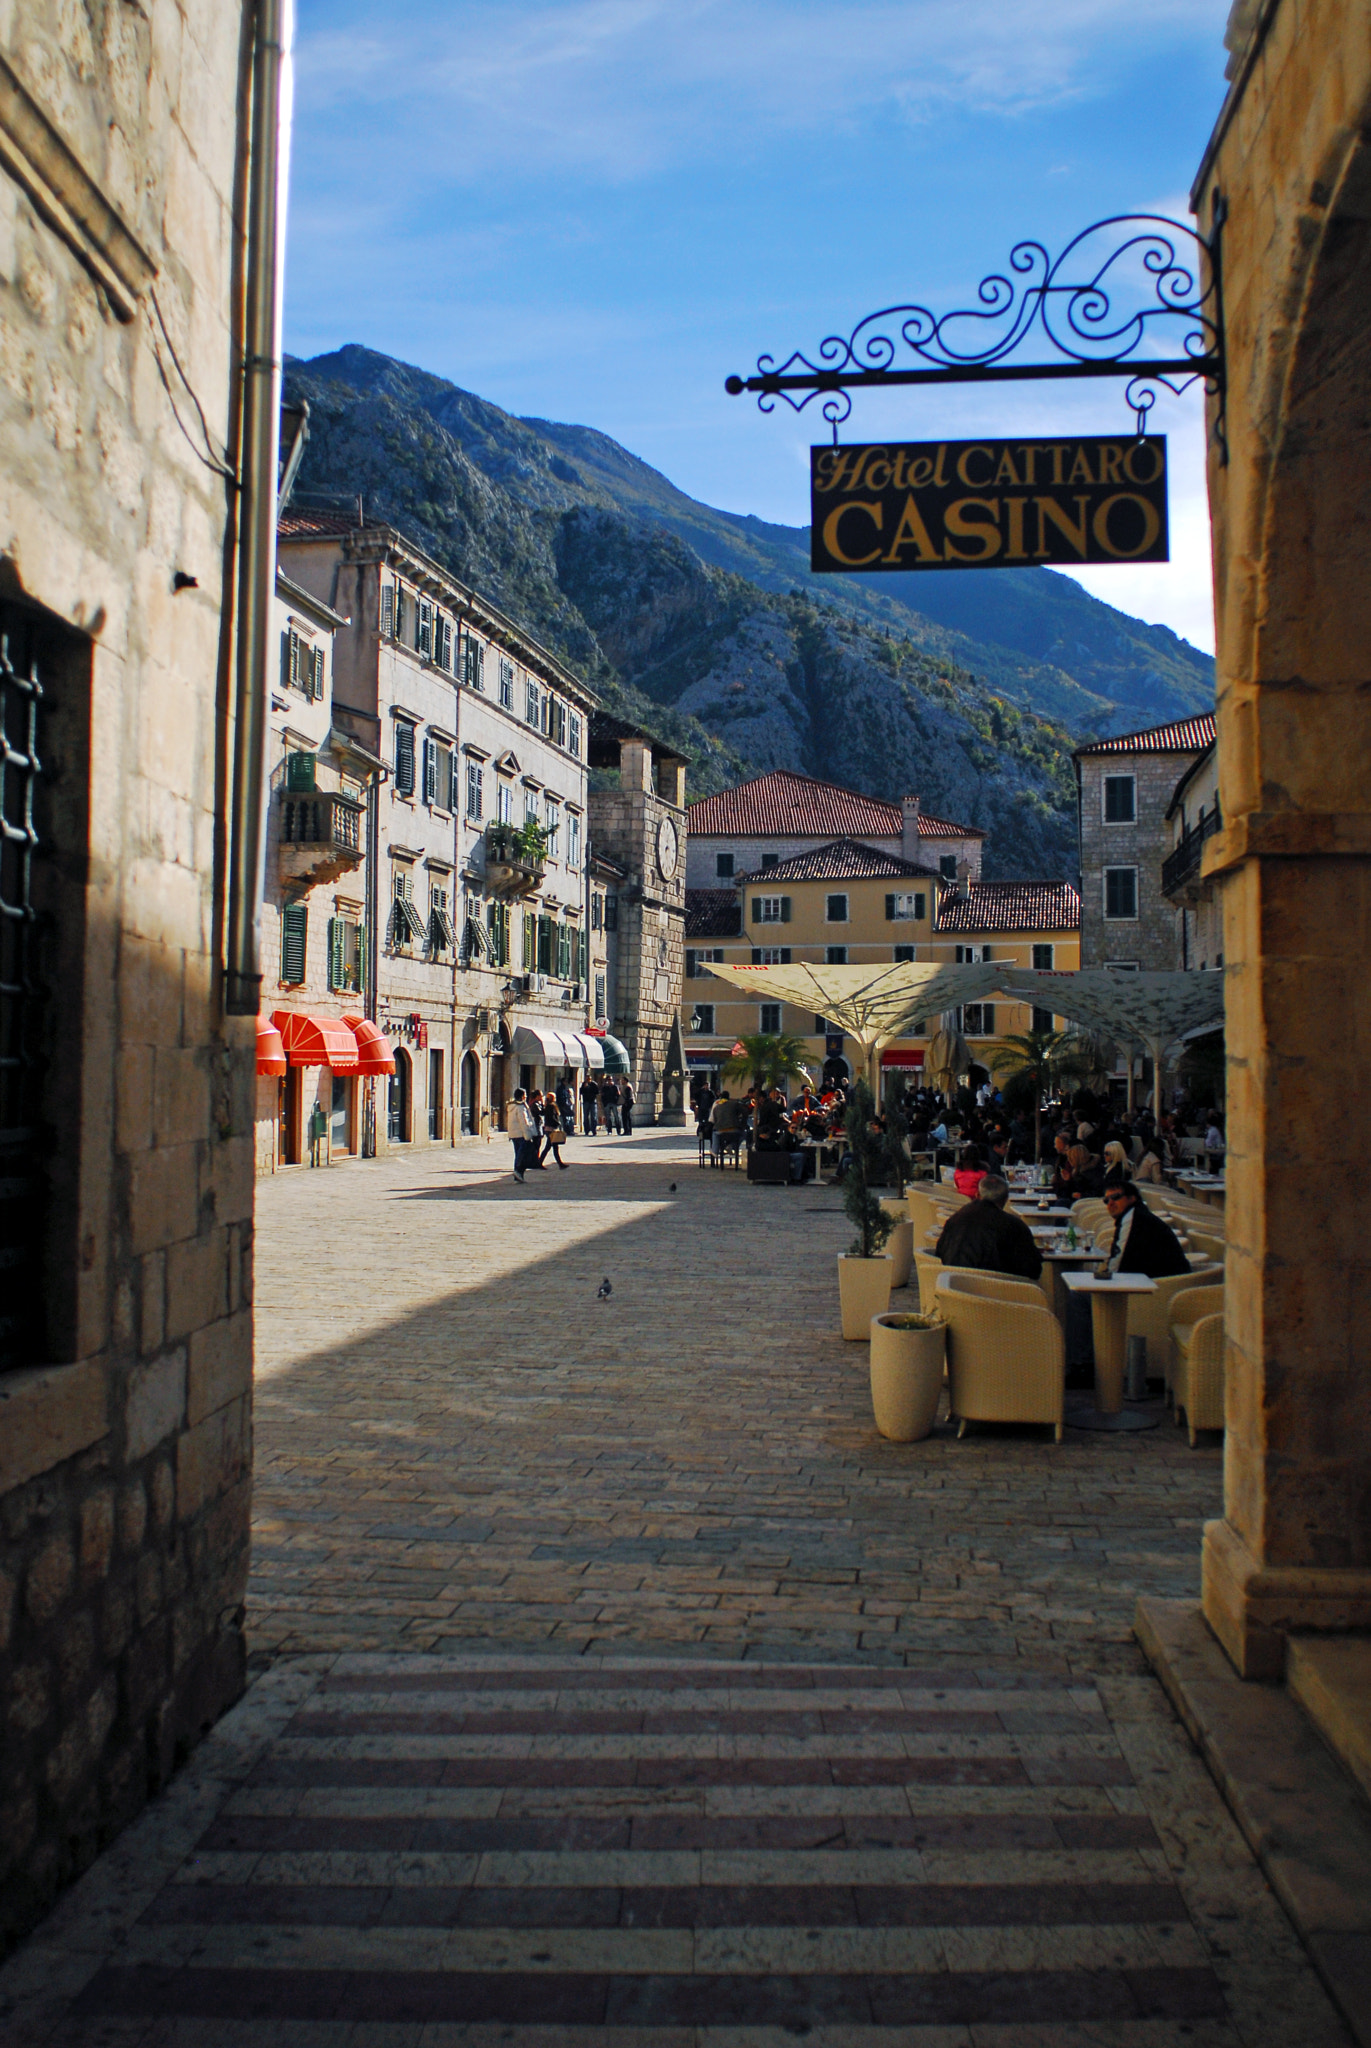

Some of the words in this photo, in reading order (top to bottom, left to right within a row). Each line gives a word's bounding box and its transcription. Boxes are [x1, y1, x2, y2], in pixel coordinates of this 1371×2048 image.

[814, 444, 950, 492] Hotel
[956, 443, 1164, 487] CATTARO
[822, 492, 1160, 566] CASINO
